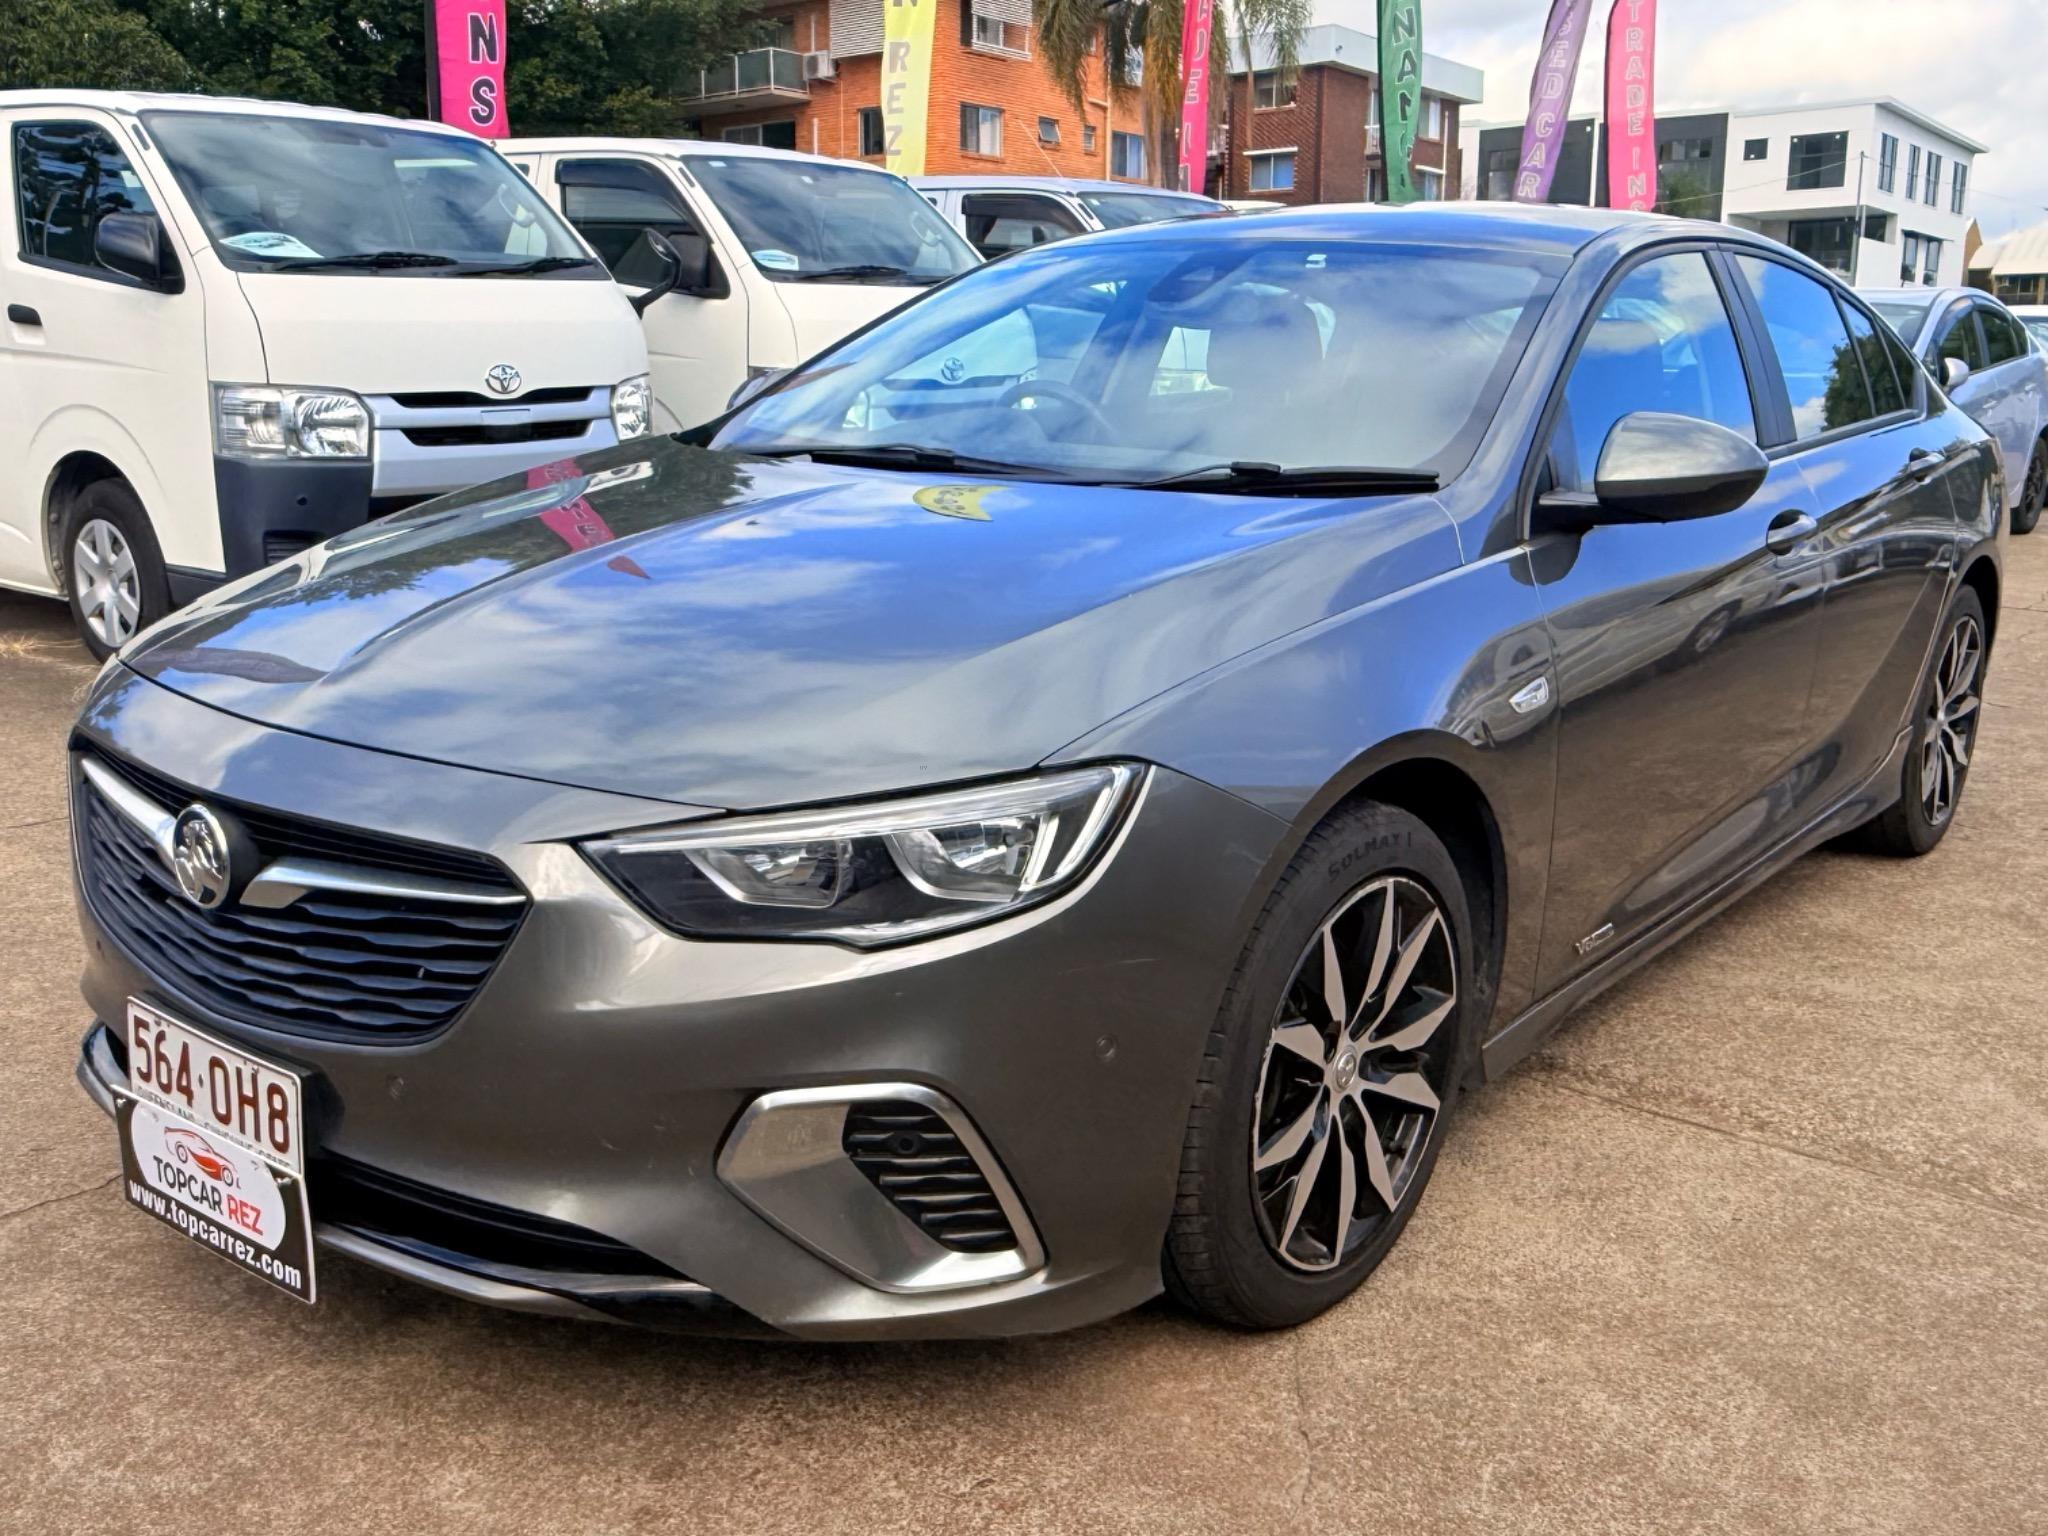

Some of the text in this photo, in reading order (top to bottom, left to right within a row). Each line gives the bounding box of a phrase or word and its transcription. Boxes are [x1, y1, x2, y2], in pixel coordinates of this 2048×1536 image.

[1624, 0, 1645, 136] TRADE
[1518, 112, 1555, 198] CAR
[129, 1179, 301, 1290] www.topcarrez.com
[153, 1155, 264, 1236] TOPCAR REZ
